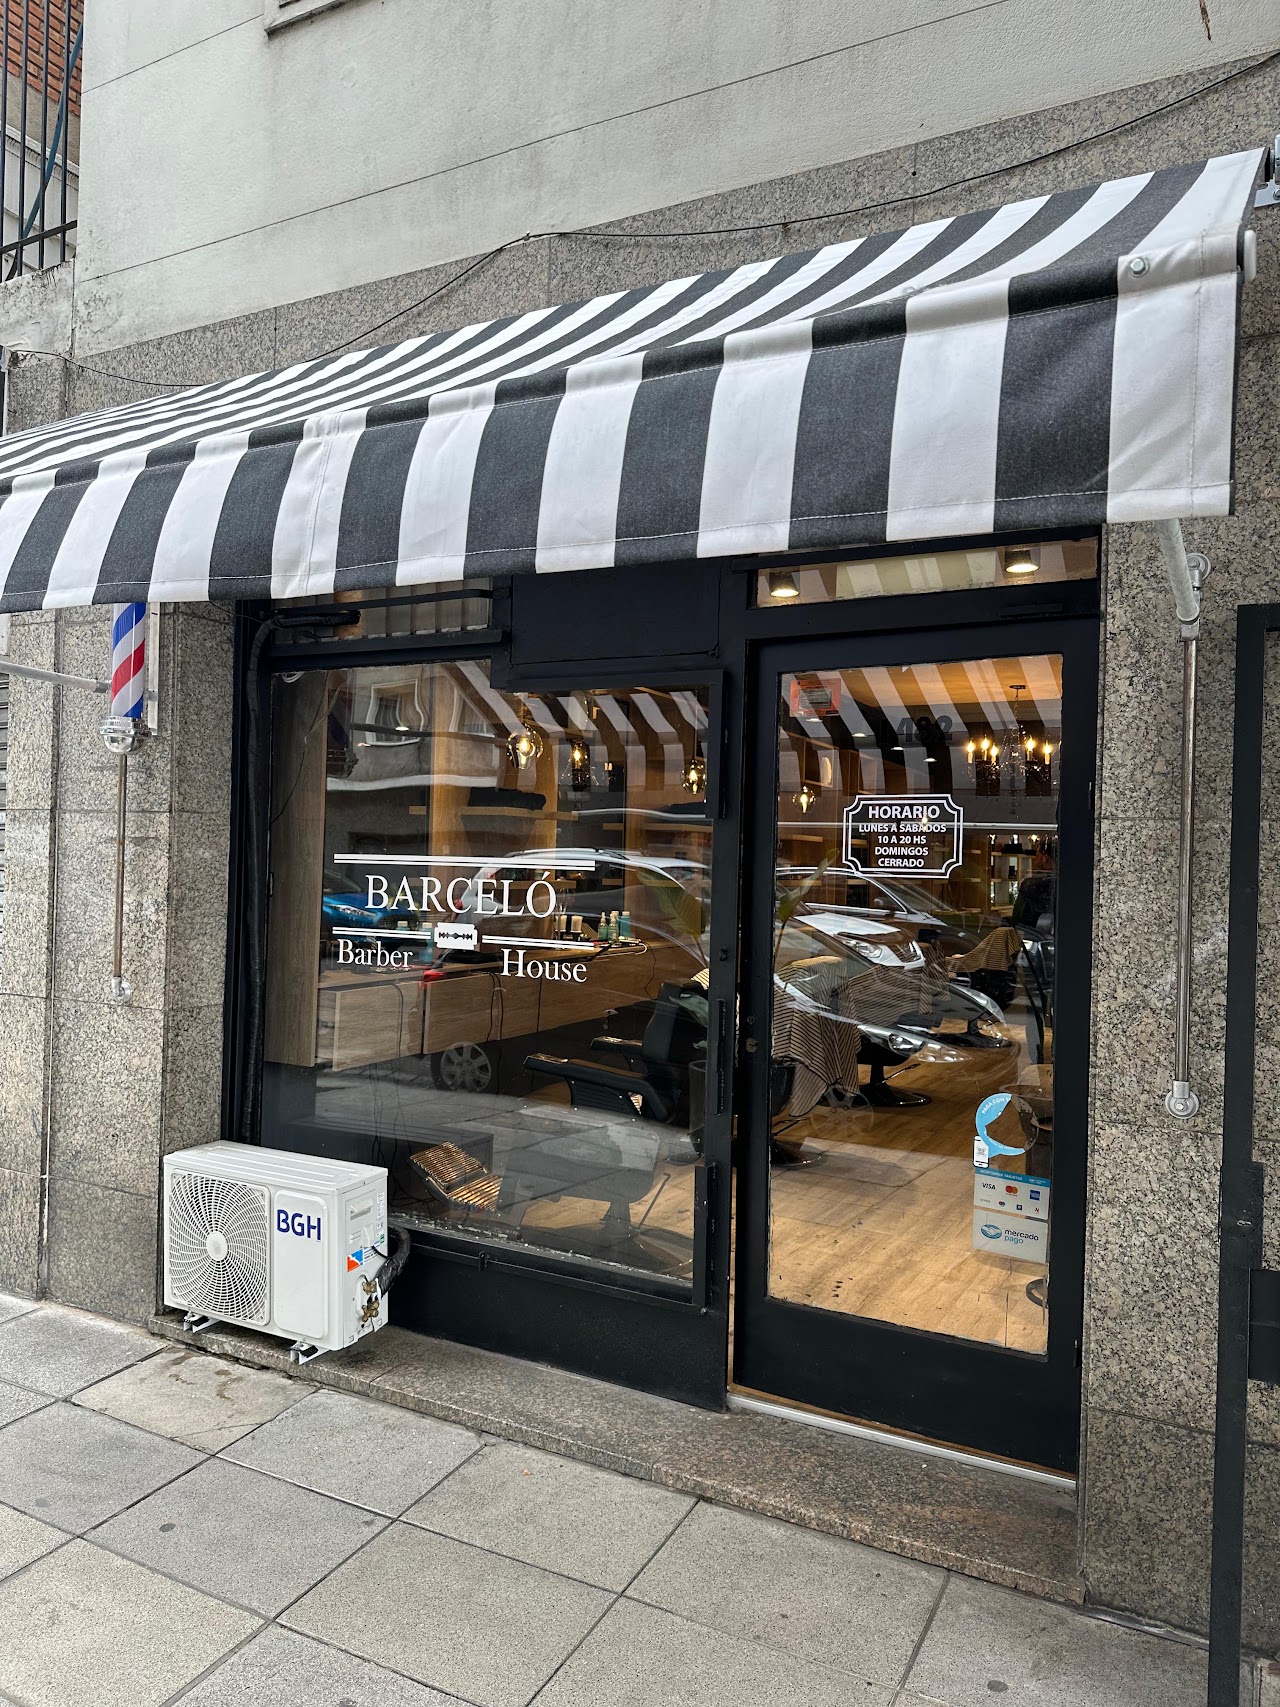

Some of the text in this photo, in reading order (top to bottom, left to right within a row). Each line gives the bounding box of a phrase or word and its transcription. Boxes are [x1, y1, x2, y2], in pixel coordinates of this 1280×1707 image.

[868, 805, 940, 819] HORARIO
[859, 823, 889, 833] LUNES
[877, 835, 927, 844] 10 A 20 HS
[874, 846, 929, 856] DOMINGOS
[878, 858, 925, 868] CERRADO
[365, 871, 557, 919] BARCELÓ
[336, 938, 588, 983] Barber House
[982, 1182, 996, 1190] VISA
[276, 1209, 321, 1241] BGH
[1004, 1229, 1039, 1241] mercado
[1004, 1235, 1024, 1245] pago
